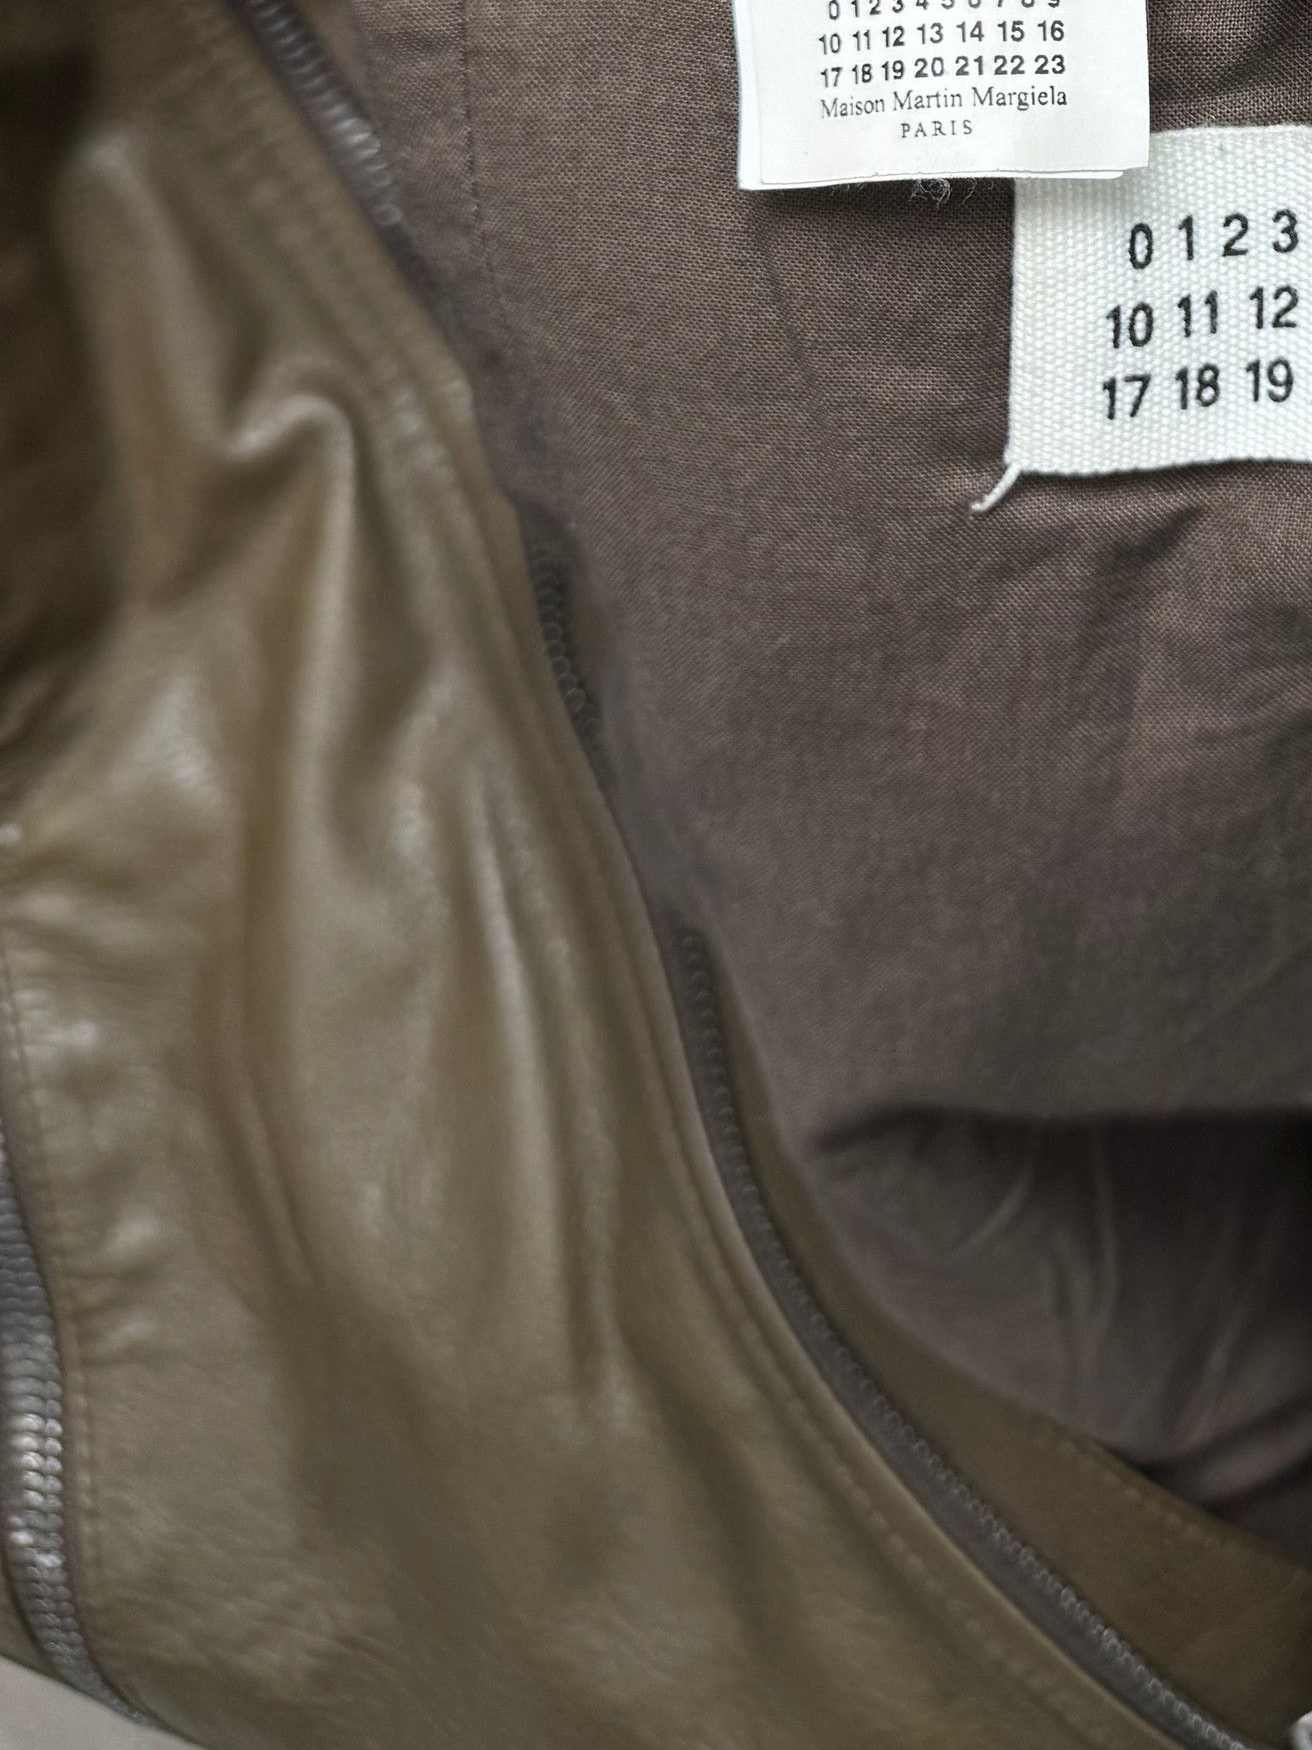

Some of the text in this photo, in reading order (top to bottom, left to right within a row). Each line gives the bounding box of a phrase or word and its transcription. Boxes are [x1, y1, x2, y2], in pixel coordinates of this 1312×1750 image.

[829, 0, 840, 20] 0
[819, 20, 1064, 55] 10 11 12 13 14 15 16
[820, 54, 1066, 89] 17 18 19 20 21 22 23
[820, 85, 1068, 119] Maison Martin Margiela
[900, 120, 973, 139] PARIS
[1128, 223, 1154, 269] 0
[1179, 215, 1195, 260] 1
[1223, 213, 1249, 257] 2
[1273, 209, 1299, 253] 3
[1107, 305, 1154, 349] 10
[1177, 291, 1219, 336] 11
[1249, 286, 1298, 330] 12
[1102, 374, 1152, 419] 17
[1175, 363, 1221, 409] 18
[1246, 359, 1293, 402] 19
